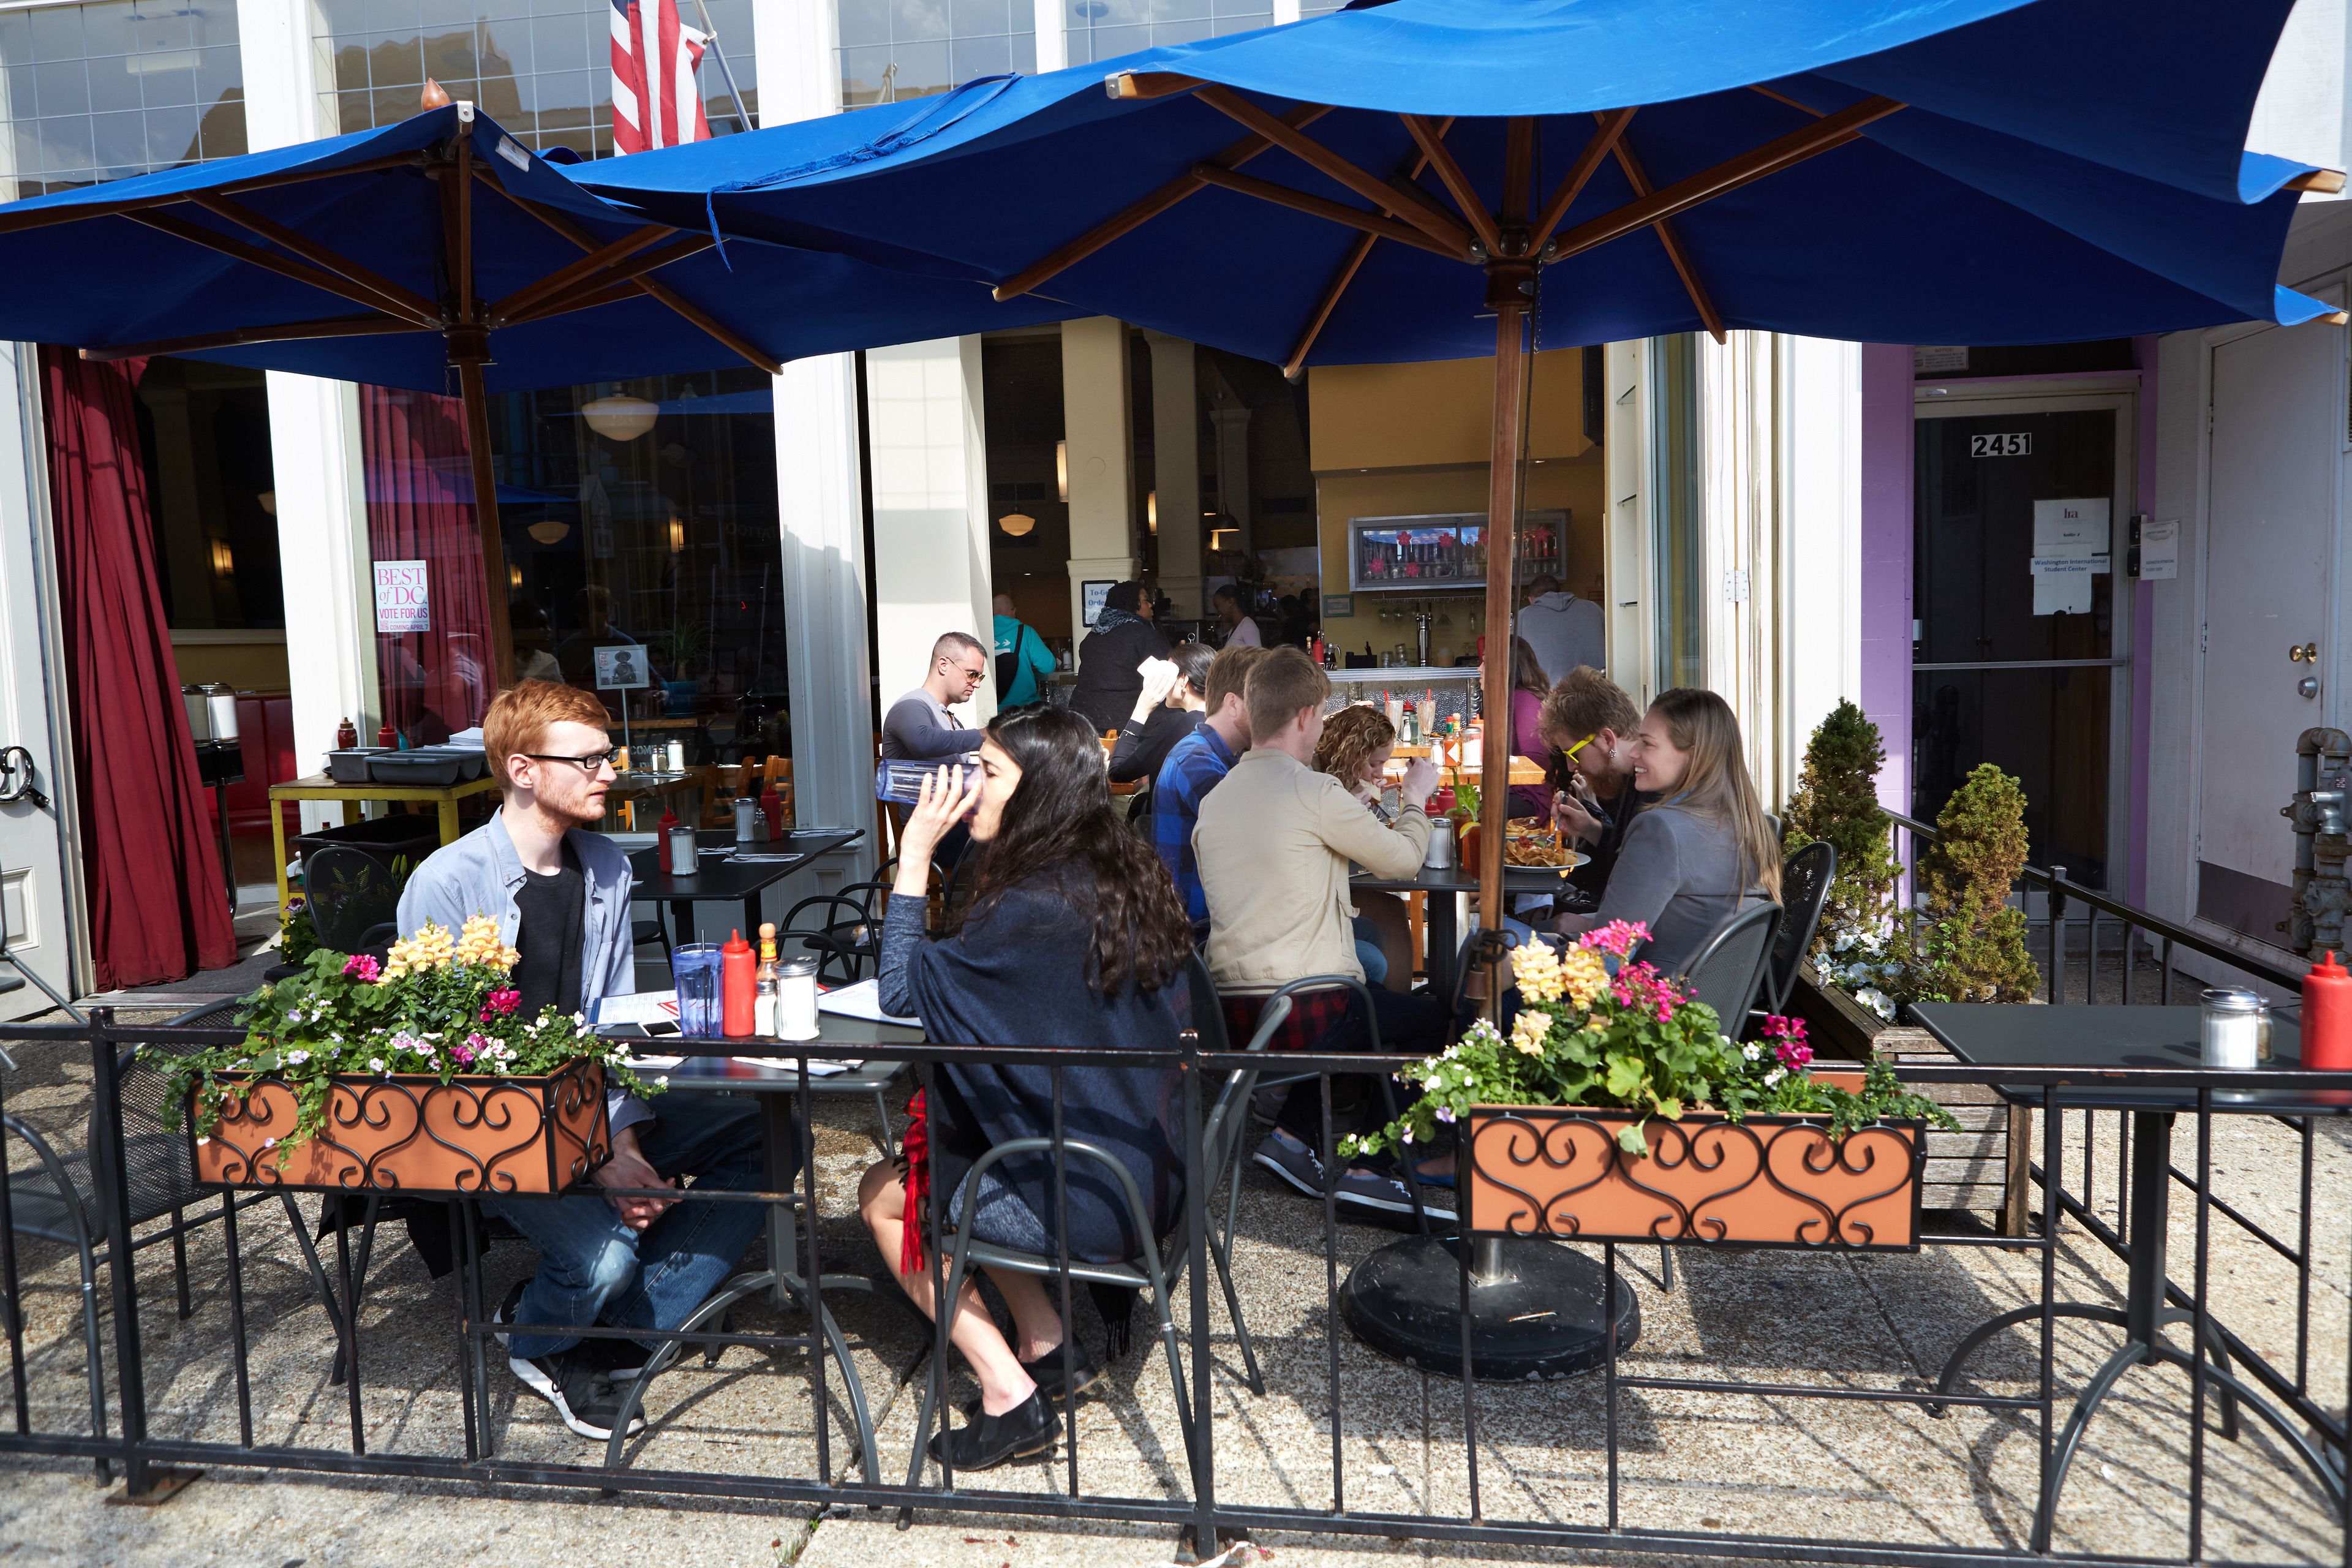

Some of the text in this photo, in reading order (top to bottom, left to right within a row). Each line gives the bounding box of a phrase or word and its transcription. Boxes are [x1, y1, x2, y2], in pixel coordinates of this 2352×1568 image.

[1973, 434, 2030, 456] 2451
[377, 568, 425, 586] BEST
[379, 587, 393, 605] of
[379, 608, 428, 619] VOTE FOR US
